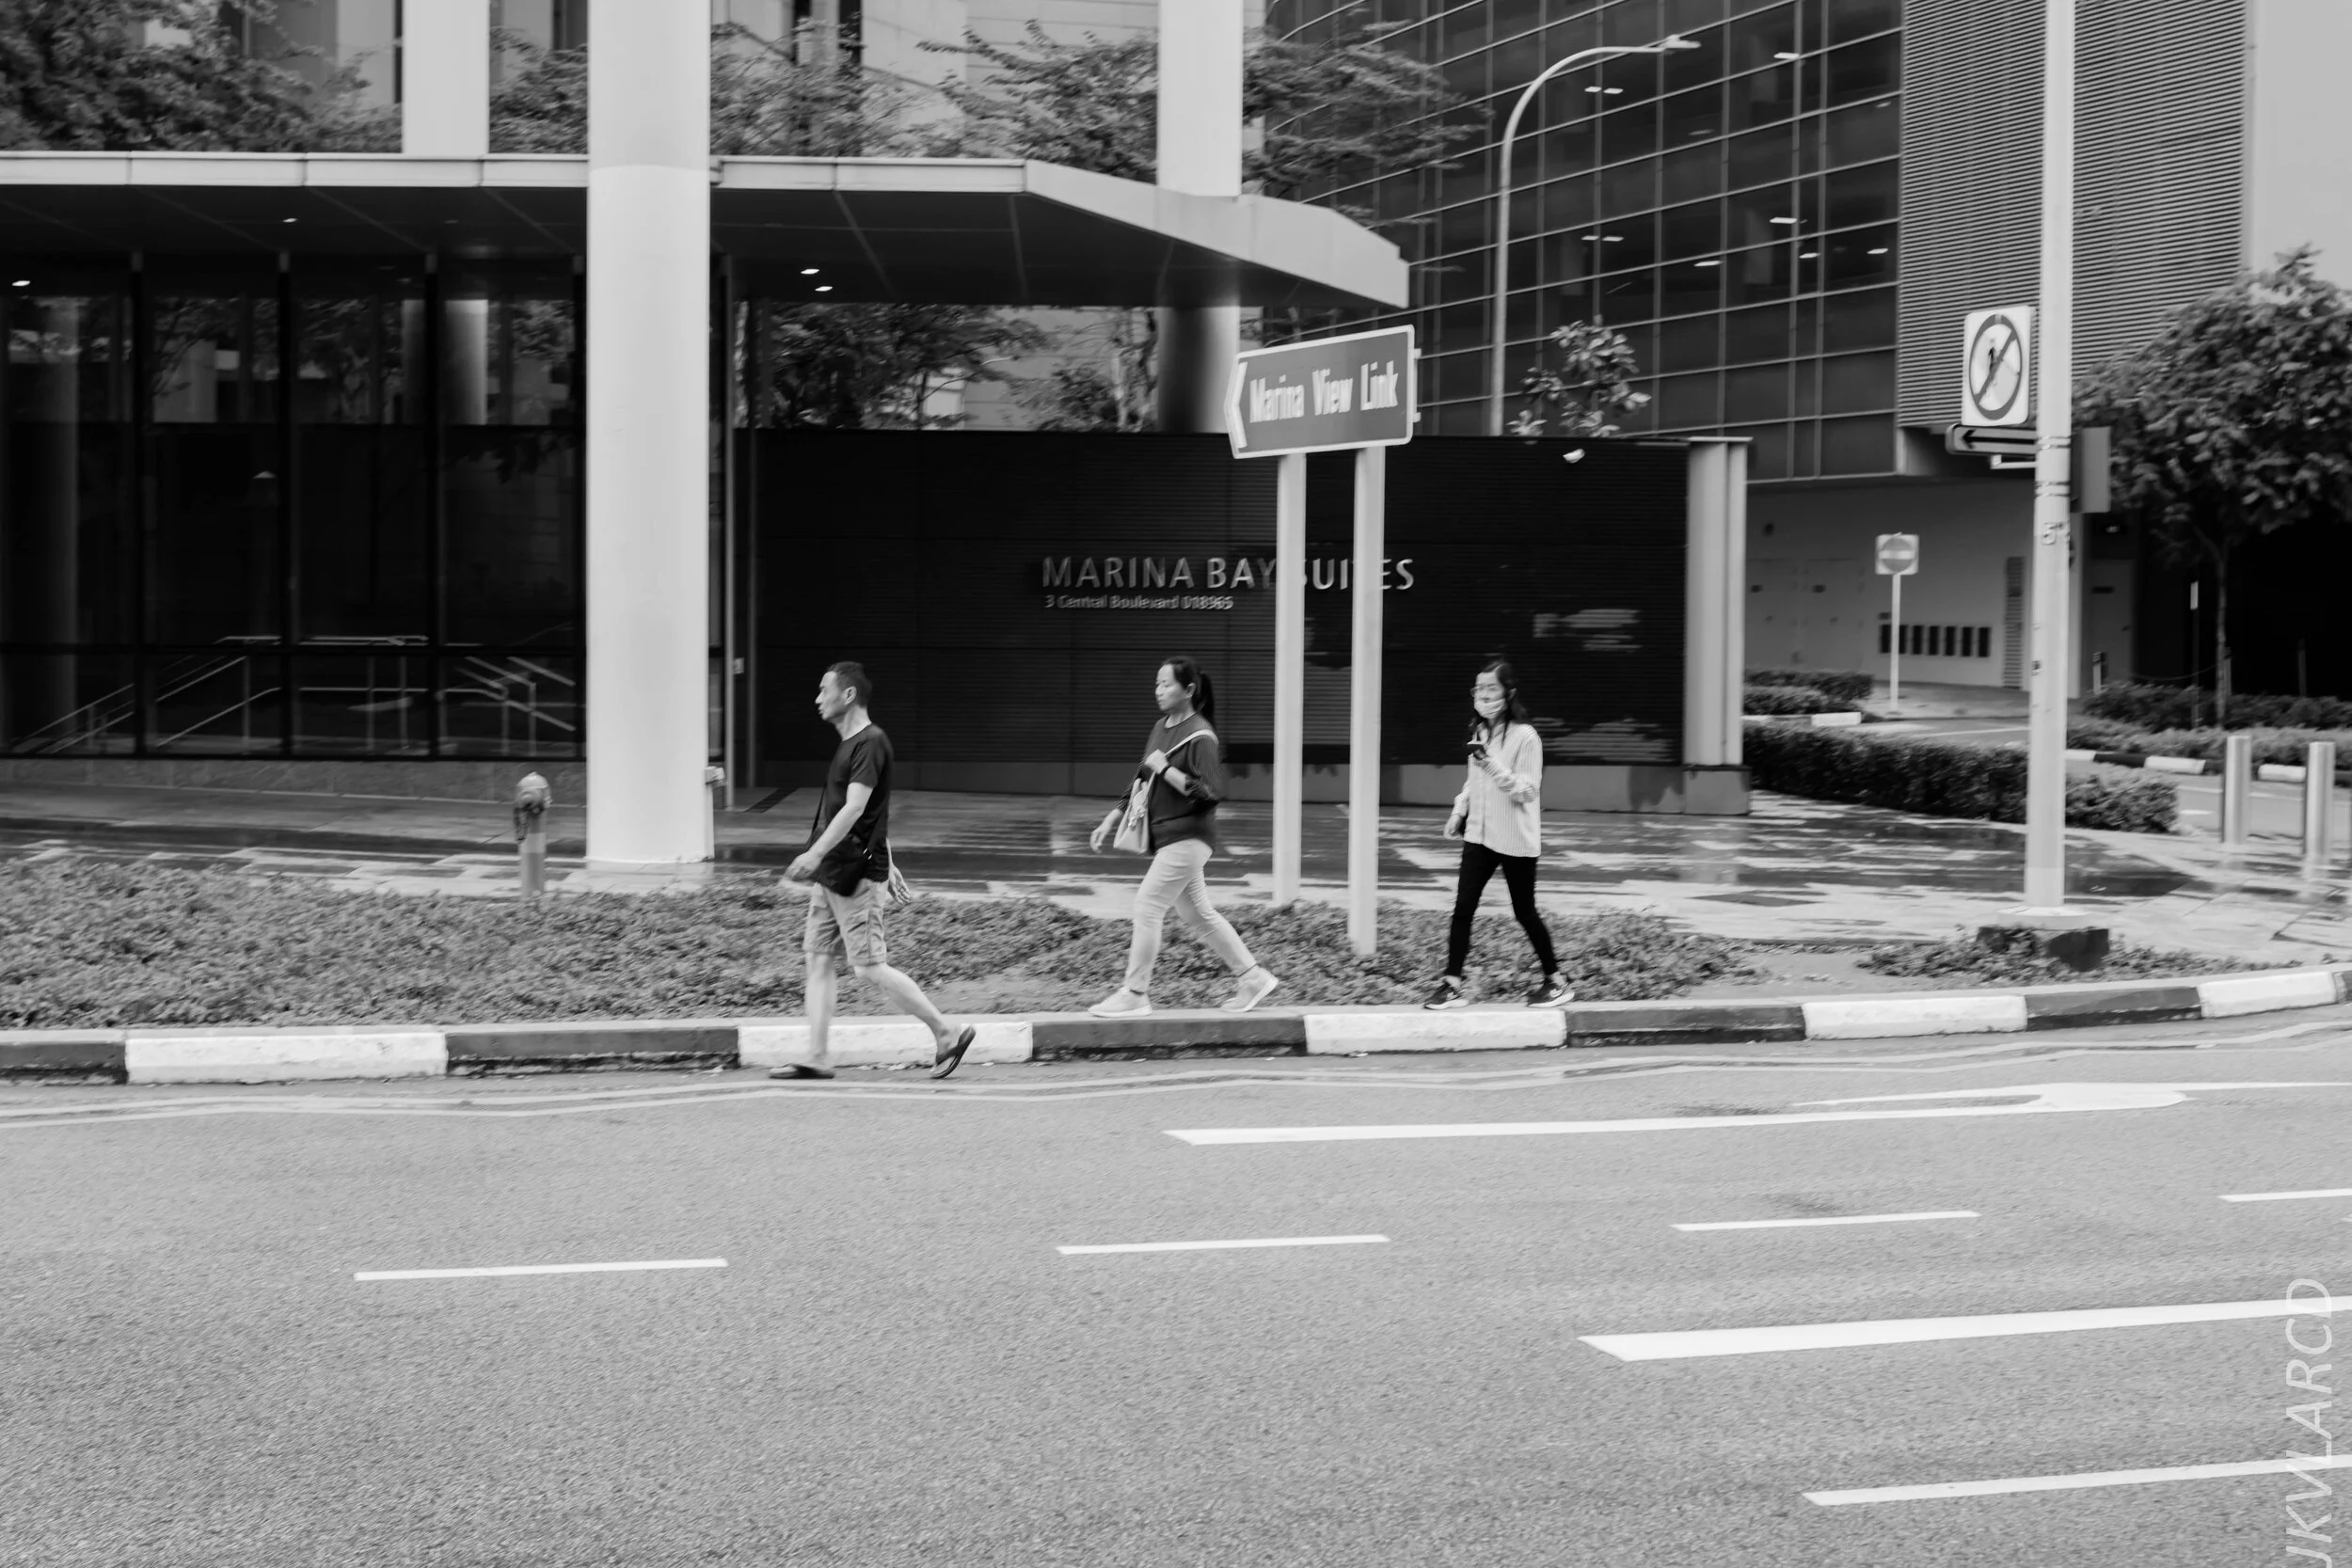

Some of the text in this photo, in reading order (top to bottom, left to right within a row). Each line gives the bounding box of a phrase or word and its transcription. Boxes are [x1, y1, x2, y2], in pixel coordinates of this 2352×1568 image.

[1249, 360, 1399, 423] Marina View Link
[1041, 556, 1415, 591] MARINA BAY UIES
[1044, 594, 1056, 609] 3
[1057, 594, 1107, 610] Central
[1109, 594, 1180, 610] Boulevard
